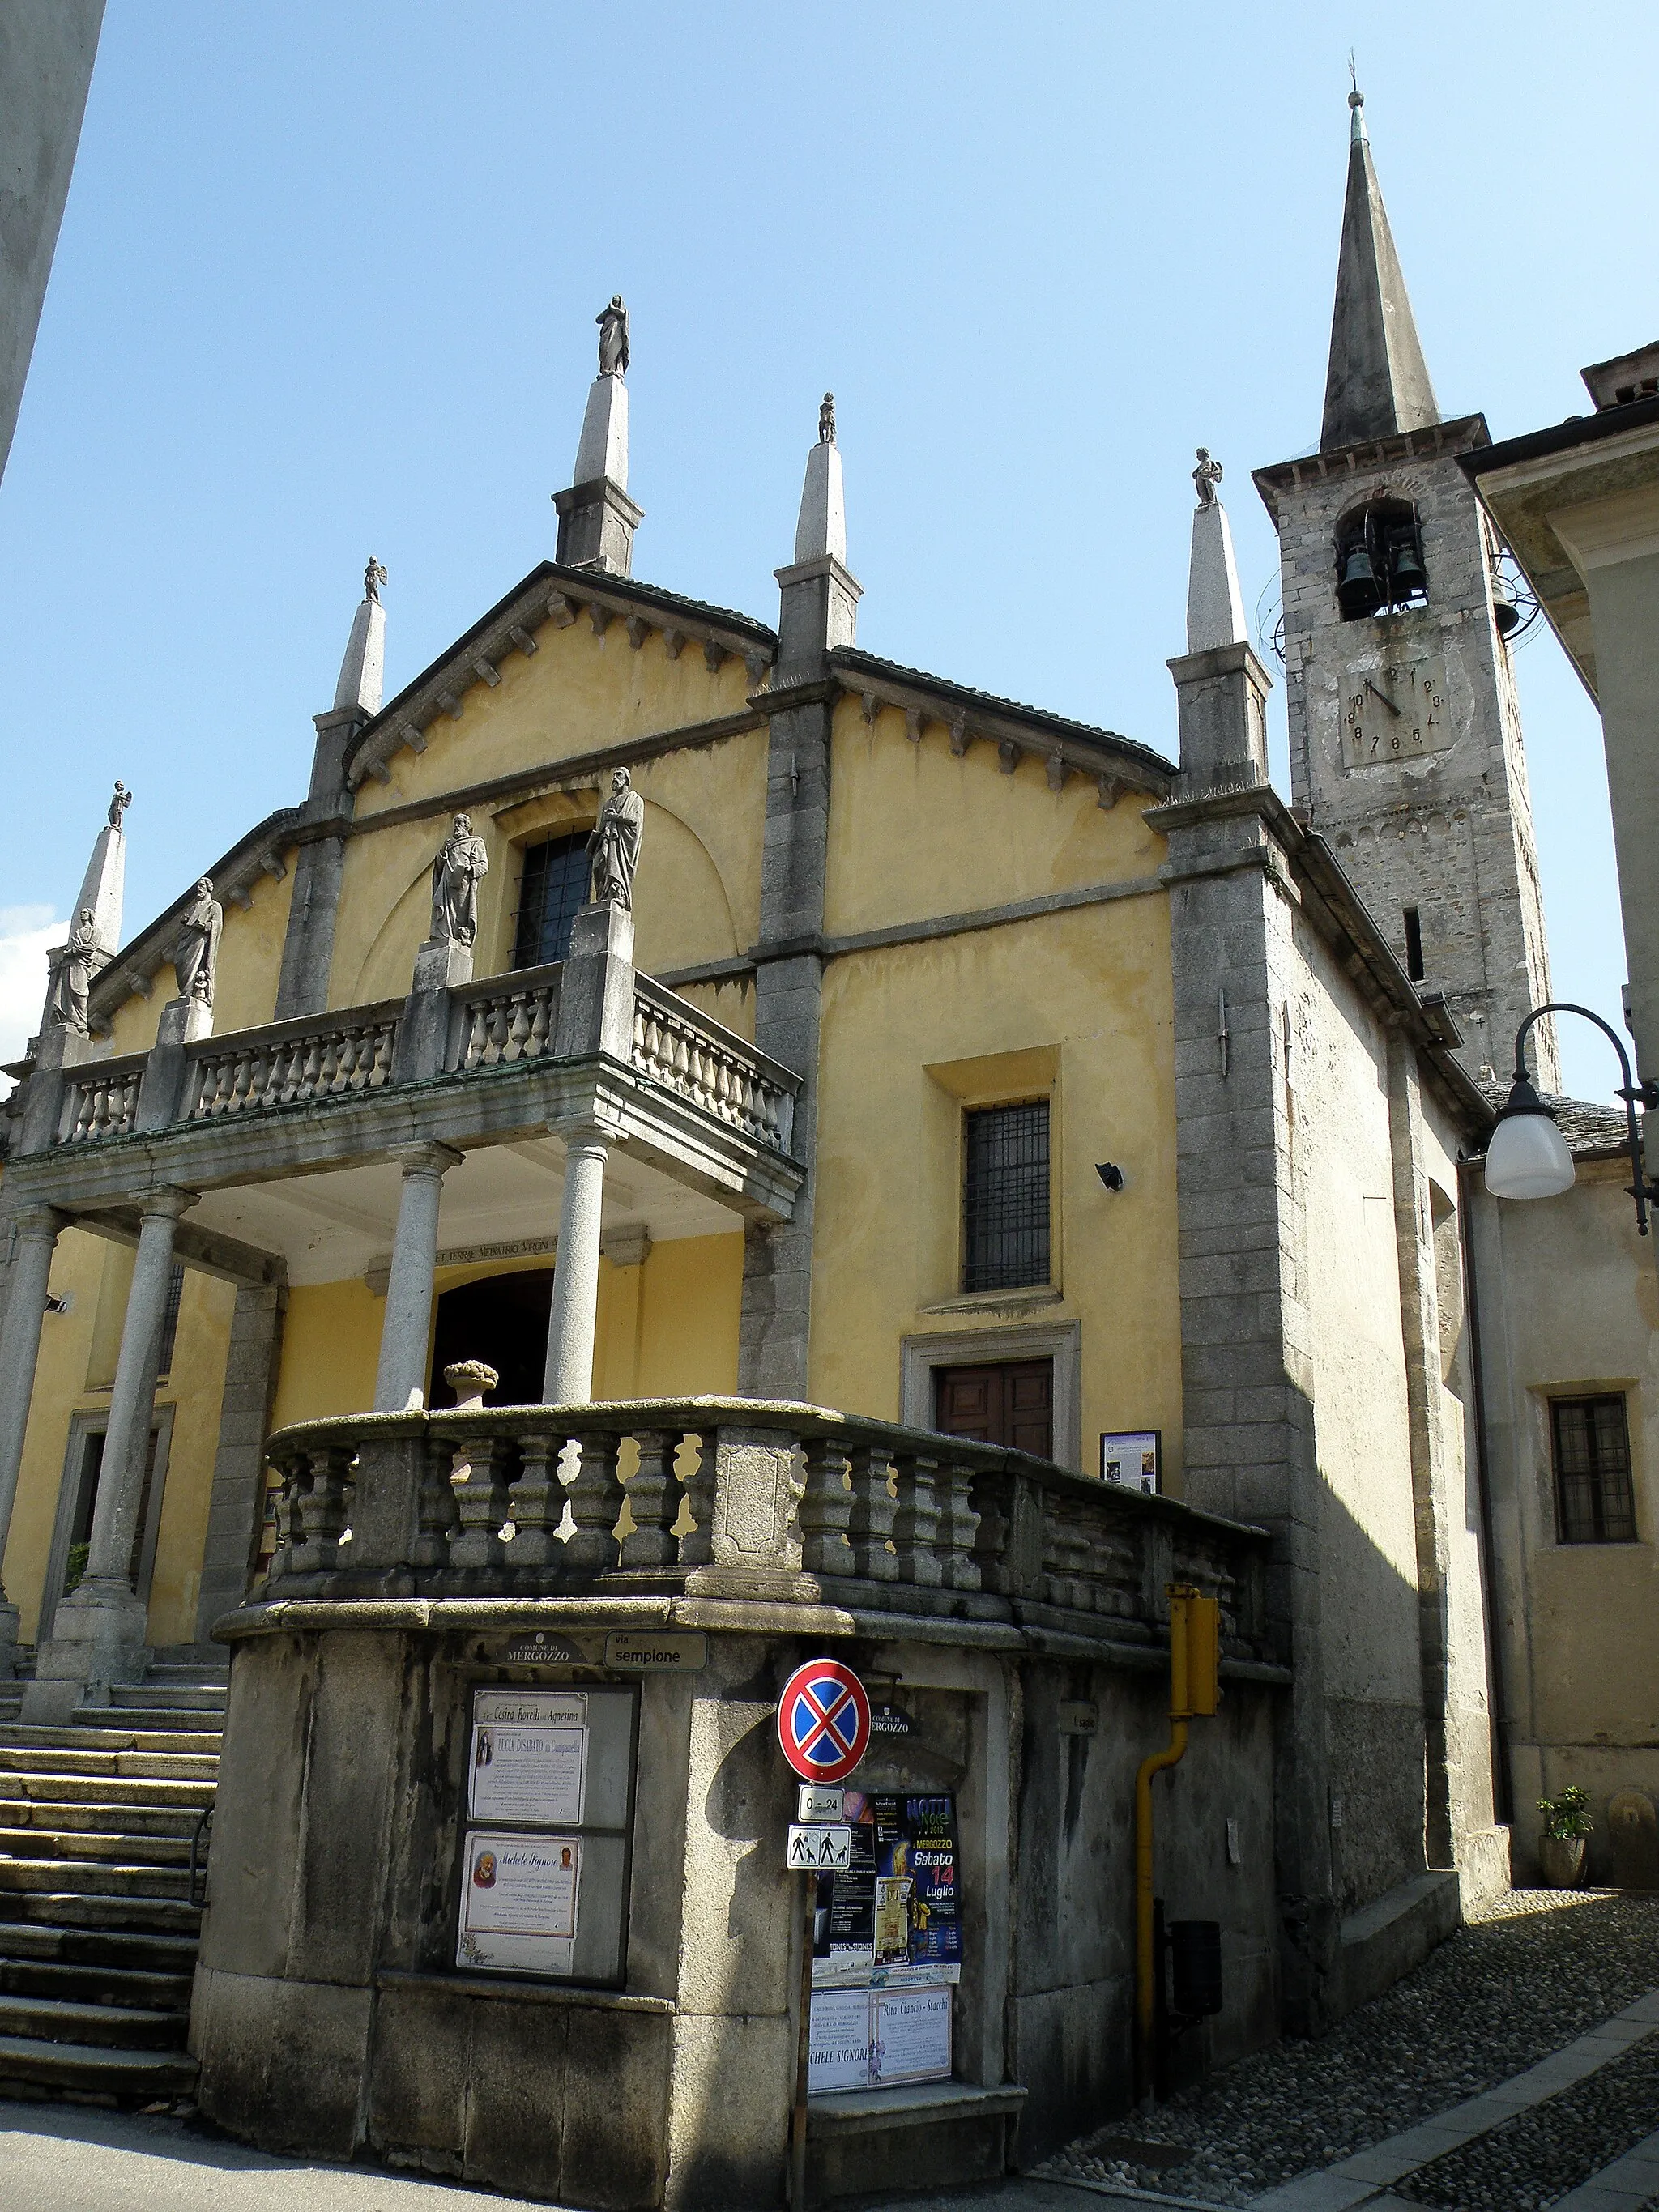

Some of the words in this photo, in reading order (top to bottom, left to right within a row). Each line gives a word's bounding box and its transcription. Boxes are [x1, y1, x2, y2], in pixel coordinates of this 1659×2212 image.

[1424, 680, 1432, 693] 2
[1351, 694, 1363, 710] 10
[1432, 695, 1439, 707] 3
[1348, 712, 1355, 724] 9
[1354, 727, 1362, 739] 8
[1413, 728, 1420, 741] 5
[1372, 736, 1380, 750] 7
[1392, 737, 1399, 749] 6
[615, 1635, 629, 1644] via
[507, 1651, 569, 1661] MERGOZZO
[615, 1649, 680, 1663] sempione
[494, 1707, 514, 1720] Cesira
[518, 1707, 540, 1720] Rovelli
[548, 1709, 578, 1724] Agnesina
[871, 1722, 909, 1733] ERGOZZO
[498, 1738, 514, 1751] LUCIA
[807, 1797, 813, 1810] 0
[826, 1799, 838, 1810] 24
[930, 1826, 944, 1834] 2012
[916, 1839, 953, 1849] MERGOZZO
[499, 1852, 527, 1865] Michele
[528, 1852, 557, 1871] Signore
[915, 1851, 953, 1866] Sabato
[932, 1866, 954, 1886] 14
[926, 1885, 954, 1900] Luglio
[884, 2002, 897, 2016] Rita
[900, 2001, 922, 2014] Ciancio
[927, 1997, 948, 2011] Stacchi
[810, 2050, 834, 2065] CHELE
